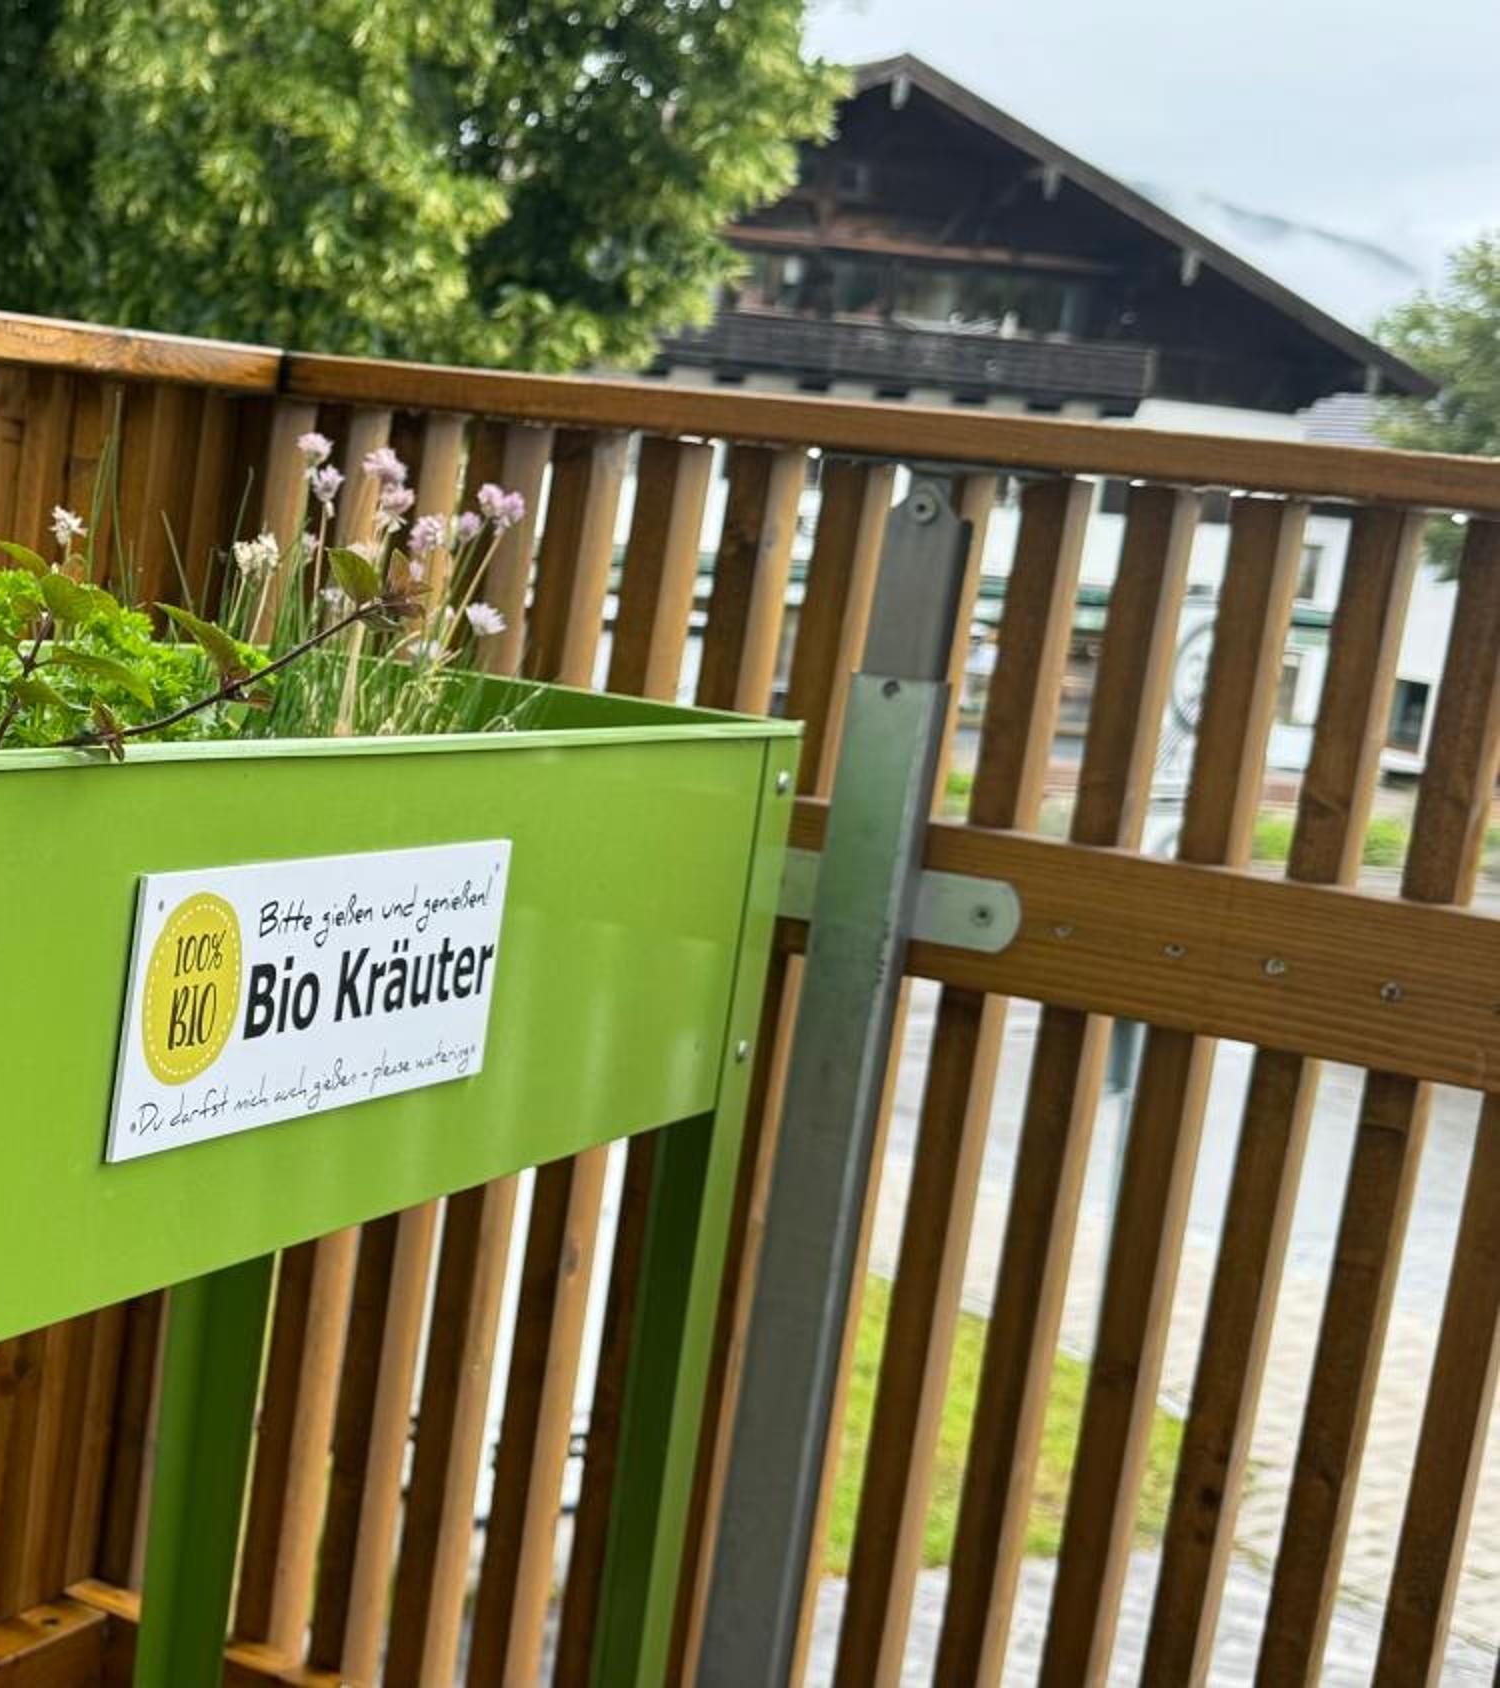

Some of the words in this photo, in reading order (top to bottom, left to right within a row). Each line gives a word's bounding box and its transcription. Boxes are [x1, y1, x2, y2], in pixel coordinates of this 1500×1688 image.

[260, 900, 312, 938] Bitte
[314, 893, 372, 947] gießen
[382, 884, 417, 918] und
[174, 929, 227, 977] 100%
[168, 981, 217, 1050] BIO
[243, 956, 319, 1039] Bio
[333, 937, 495, 1022] Kräuter
[169, 1088, 228, 1127] darfst
